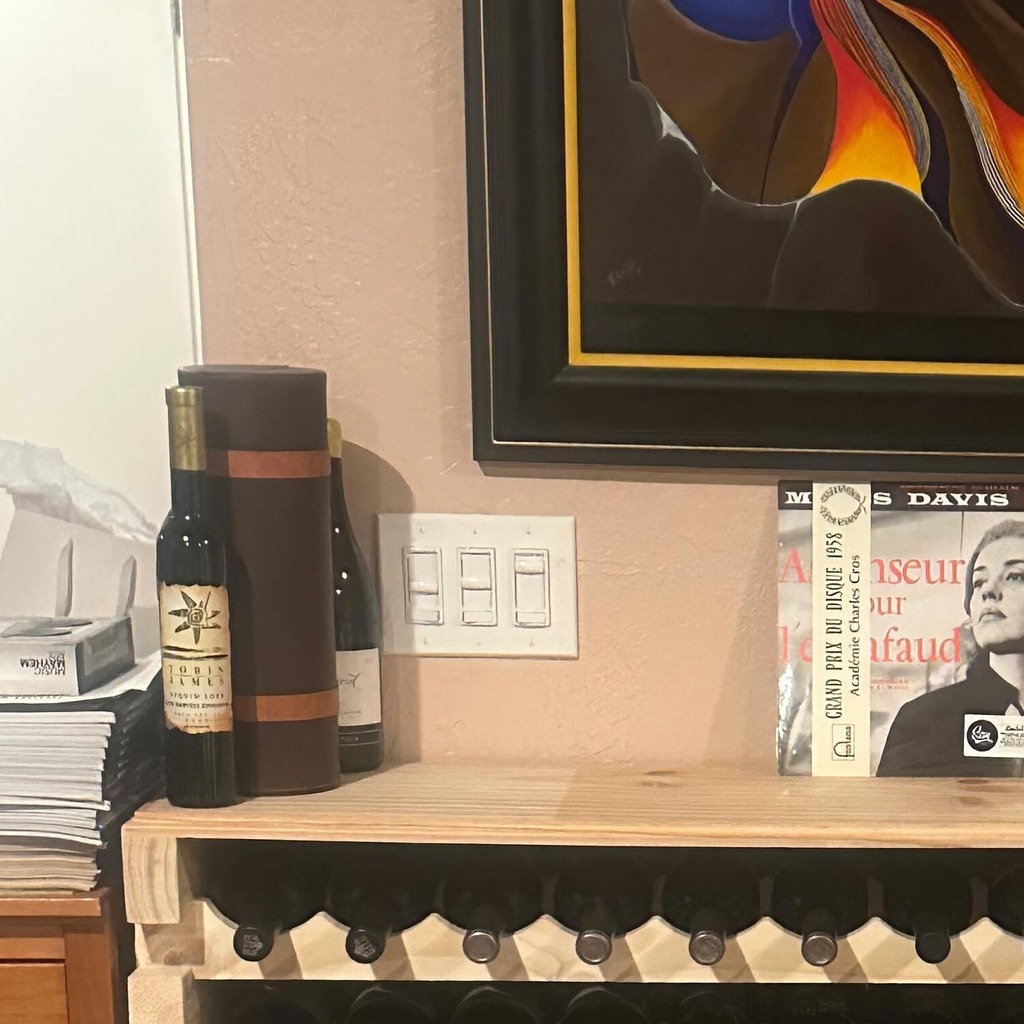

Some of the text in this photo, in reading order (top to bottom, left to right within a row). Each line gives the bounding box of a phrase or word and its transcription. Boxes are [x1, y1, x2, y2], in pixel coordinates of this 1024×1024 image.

[907, 492, 1009, 507] DAVIS
[778, 546, 966, 586] Anseur
[825, 532, 845, 719] GRAND PRIX DU DISQUE 1958
[848, 554, 860, 696] Académie Charles Cros
